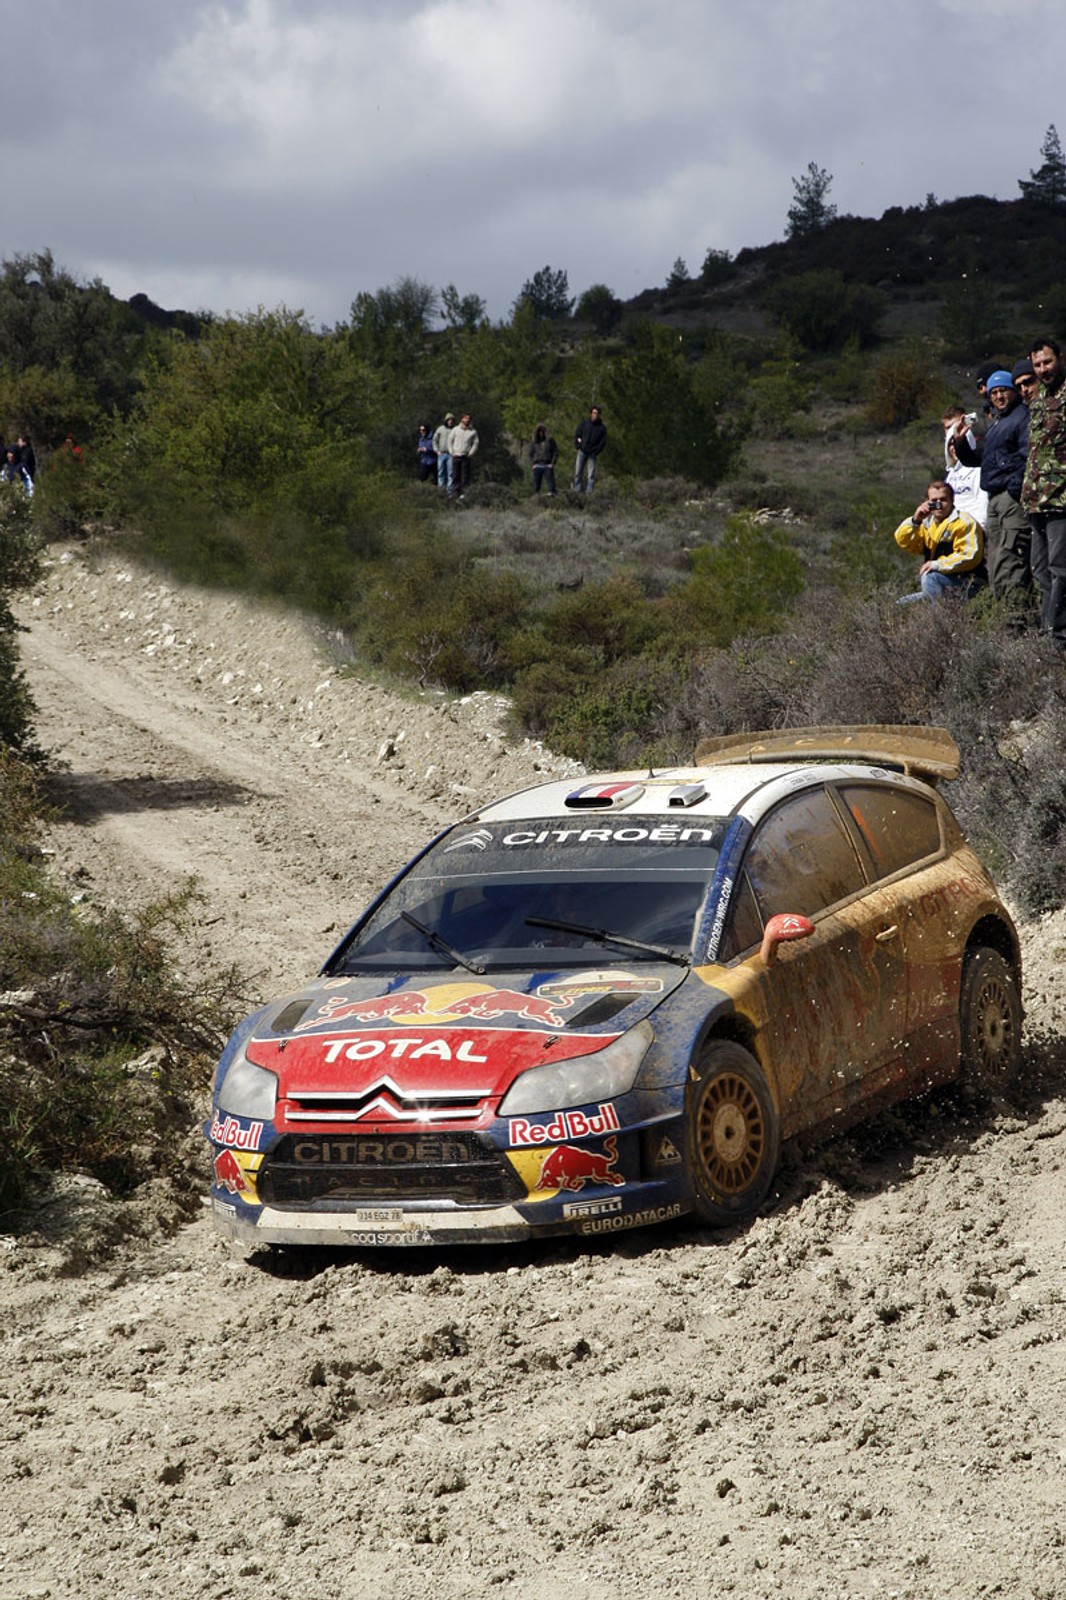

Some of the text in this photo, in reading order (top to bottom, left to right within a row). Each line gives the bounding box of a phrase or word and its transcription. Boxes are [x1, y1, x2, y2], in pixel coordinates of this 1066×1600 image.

[322, 1038, 489, 1063] TOTAL
[225, 1120, 263, 1151] Bull
[509, 1103, 620, 1146] Red Bull
[582, 1203, 681, 1235] EURODATACAR
